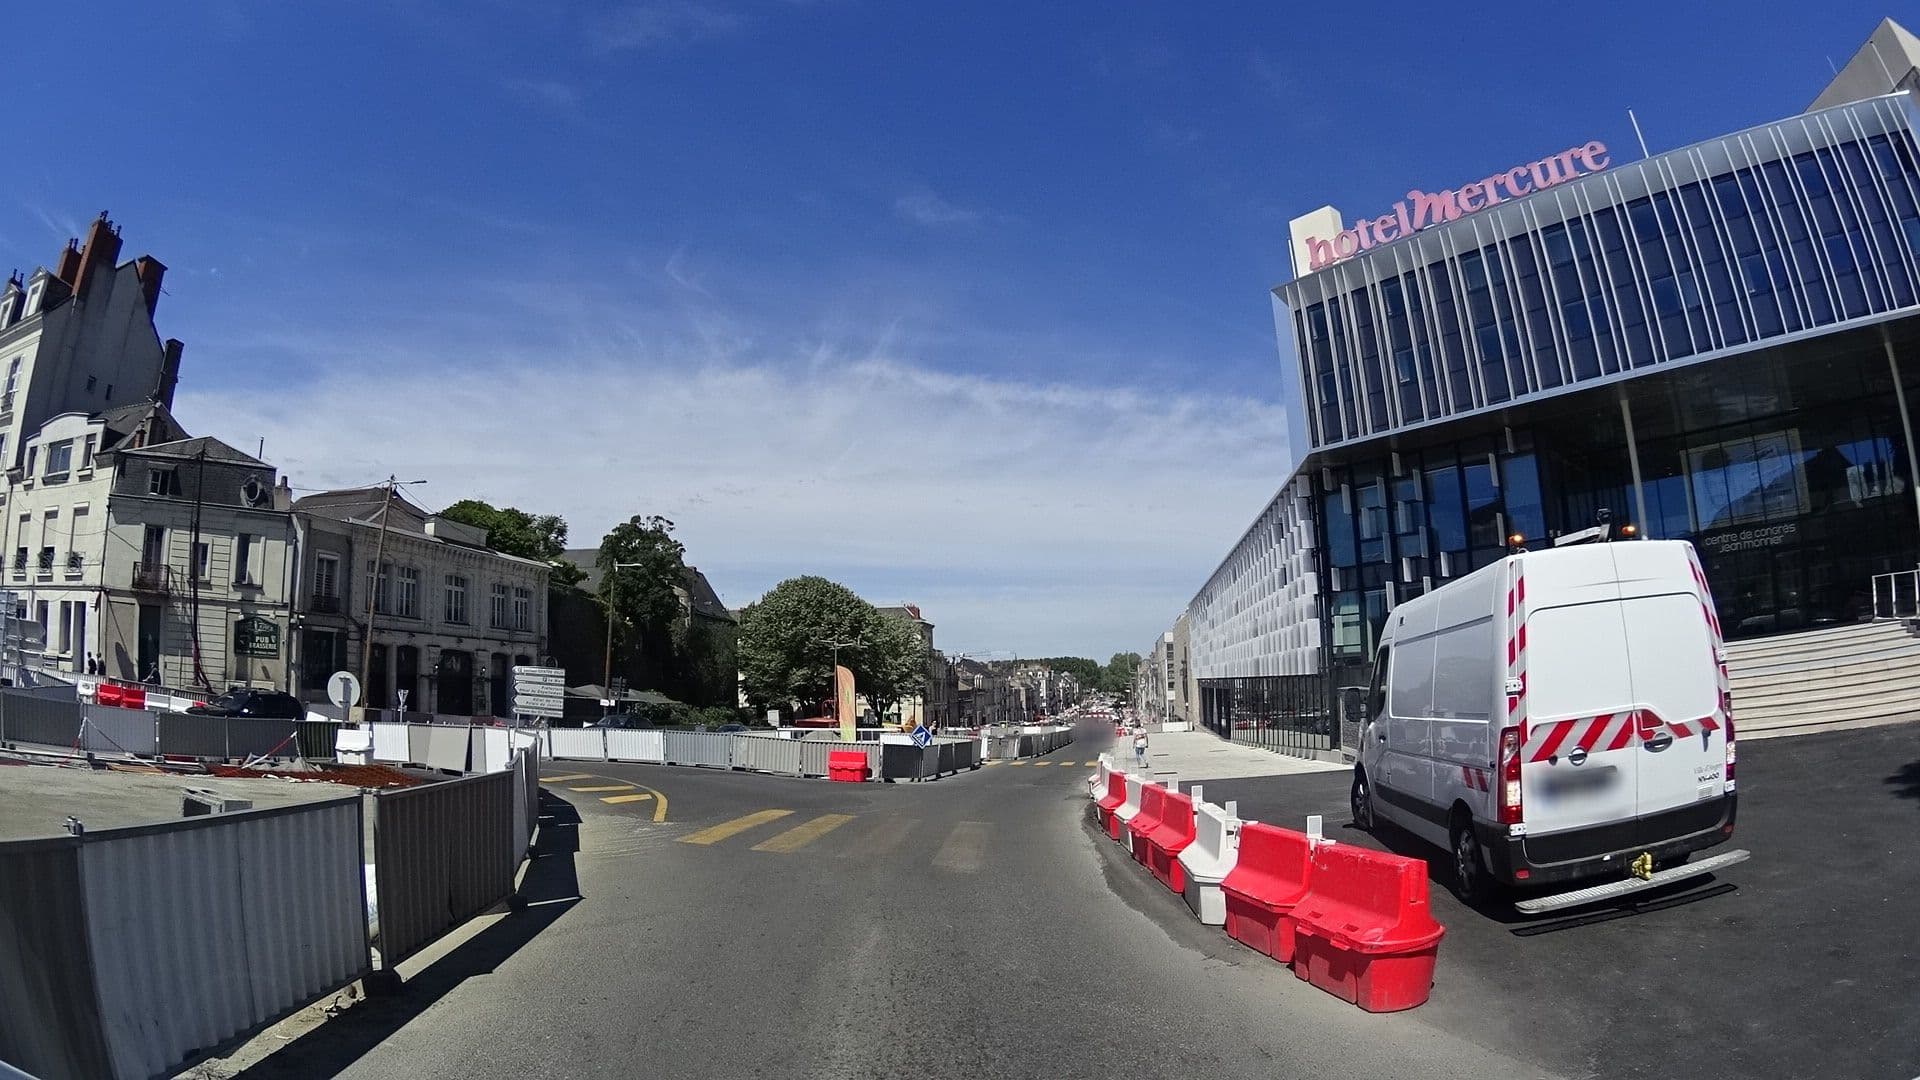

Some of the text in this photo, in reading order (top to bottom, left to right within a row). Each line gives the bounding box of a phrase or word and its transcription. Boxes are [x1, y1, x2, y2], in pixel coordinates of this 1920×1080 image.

[1704, 532, 1738, 546] centre
[1740, 529, 1753, 540] de
[1720, 541, 1743, 553] jean
